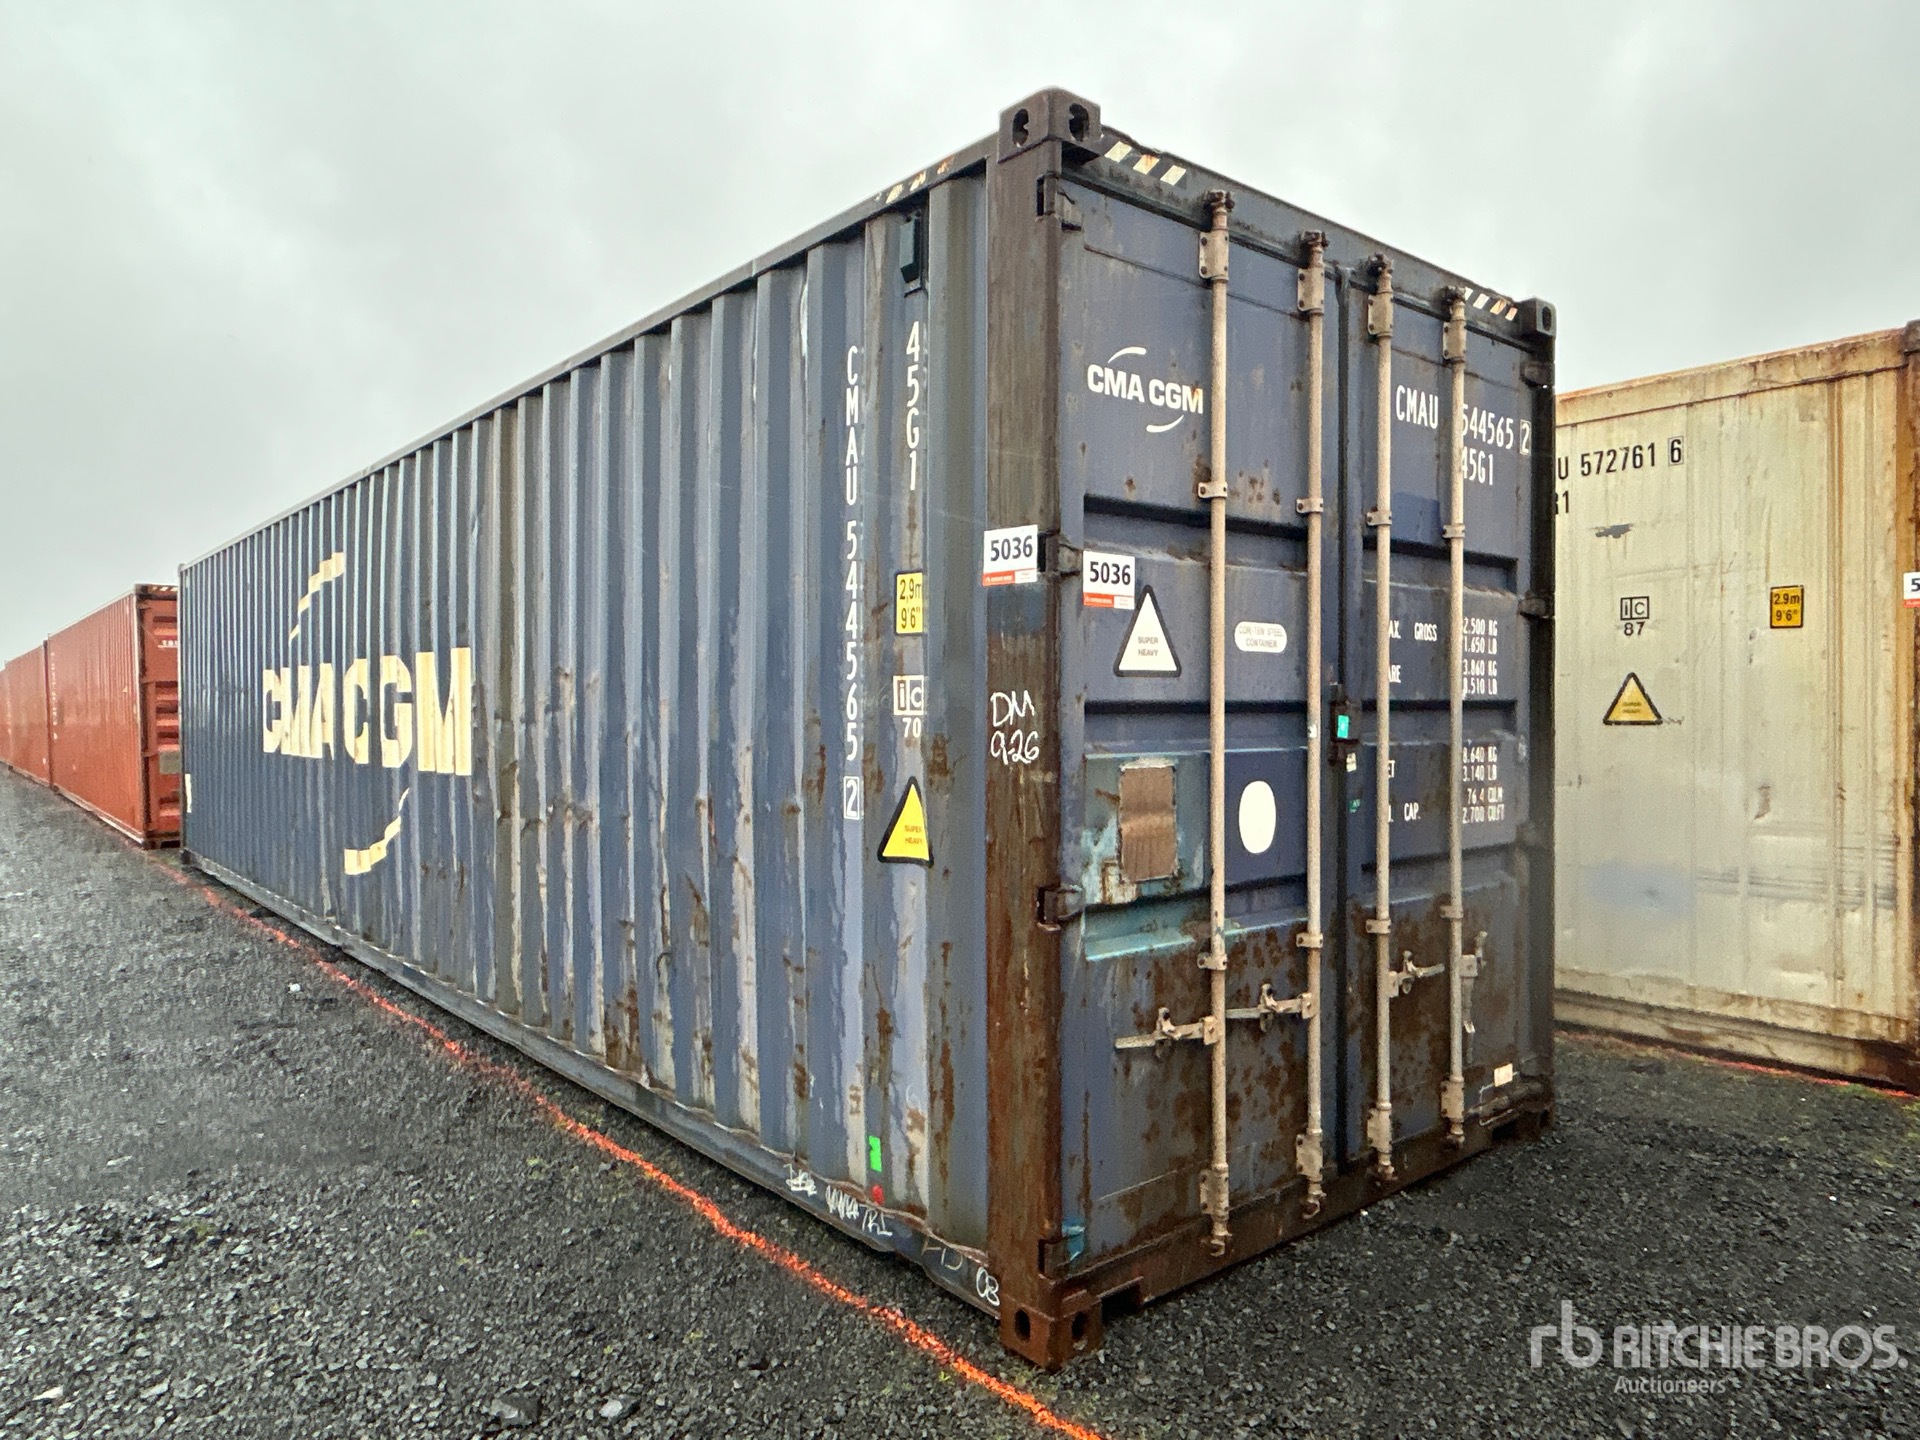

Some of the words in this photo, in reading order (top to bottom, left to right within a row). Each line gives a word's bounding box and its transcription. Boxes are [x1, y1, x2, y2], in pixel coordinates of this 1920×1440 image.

[1087, 364, 1145, 403] CMA
[1149, 378, 1203, 414] CGM
[906, 321, 920, 490] 45G1
[1396, 385, 1438, 429] CMAU
[1462, 403, 1514, 449] 544565
[1522, 422, 1531, 453] 2
[846, 346, 858, 505] CMAU
[1581, 442, 1655, 477] 572761
[1670, 439, 1682, 463] 6
[990, 535, 1033, 561] 5036
[1089, 561, 1131, 585] 5036
[845, 520, 857, 760] 544565
[1138, 636, 1159, 645] SUPER
[1414, 622, 1437, 641] GROSS
[1463, 617, 1485, 635] 2.500
[1624, 621, 1645, 636] 87
[1464, 636, 1485, 653] 1.650
[263, 662, 336, 762] CMA
[343, 647, 472, 776] CGM
[990, 690, 1036, 727] DM
[902, 717, 922, 738] 70
[1463, 765, 1485, 782] 3.140
[846, 782, 857, 817] 2
